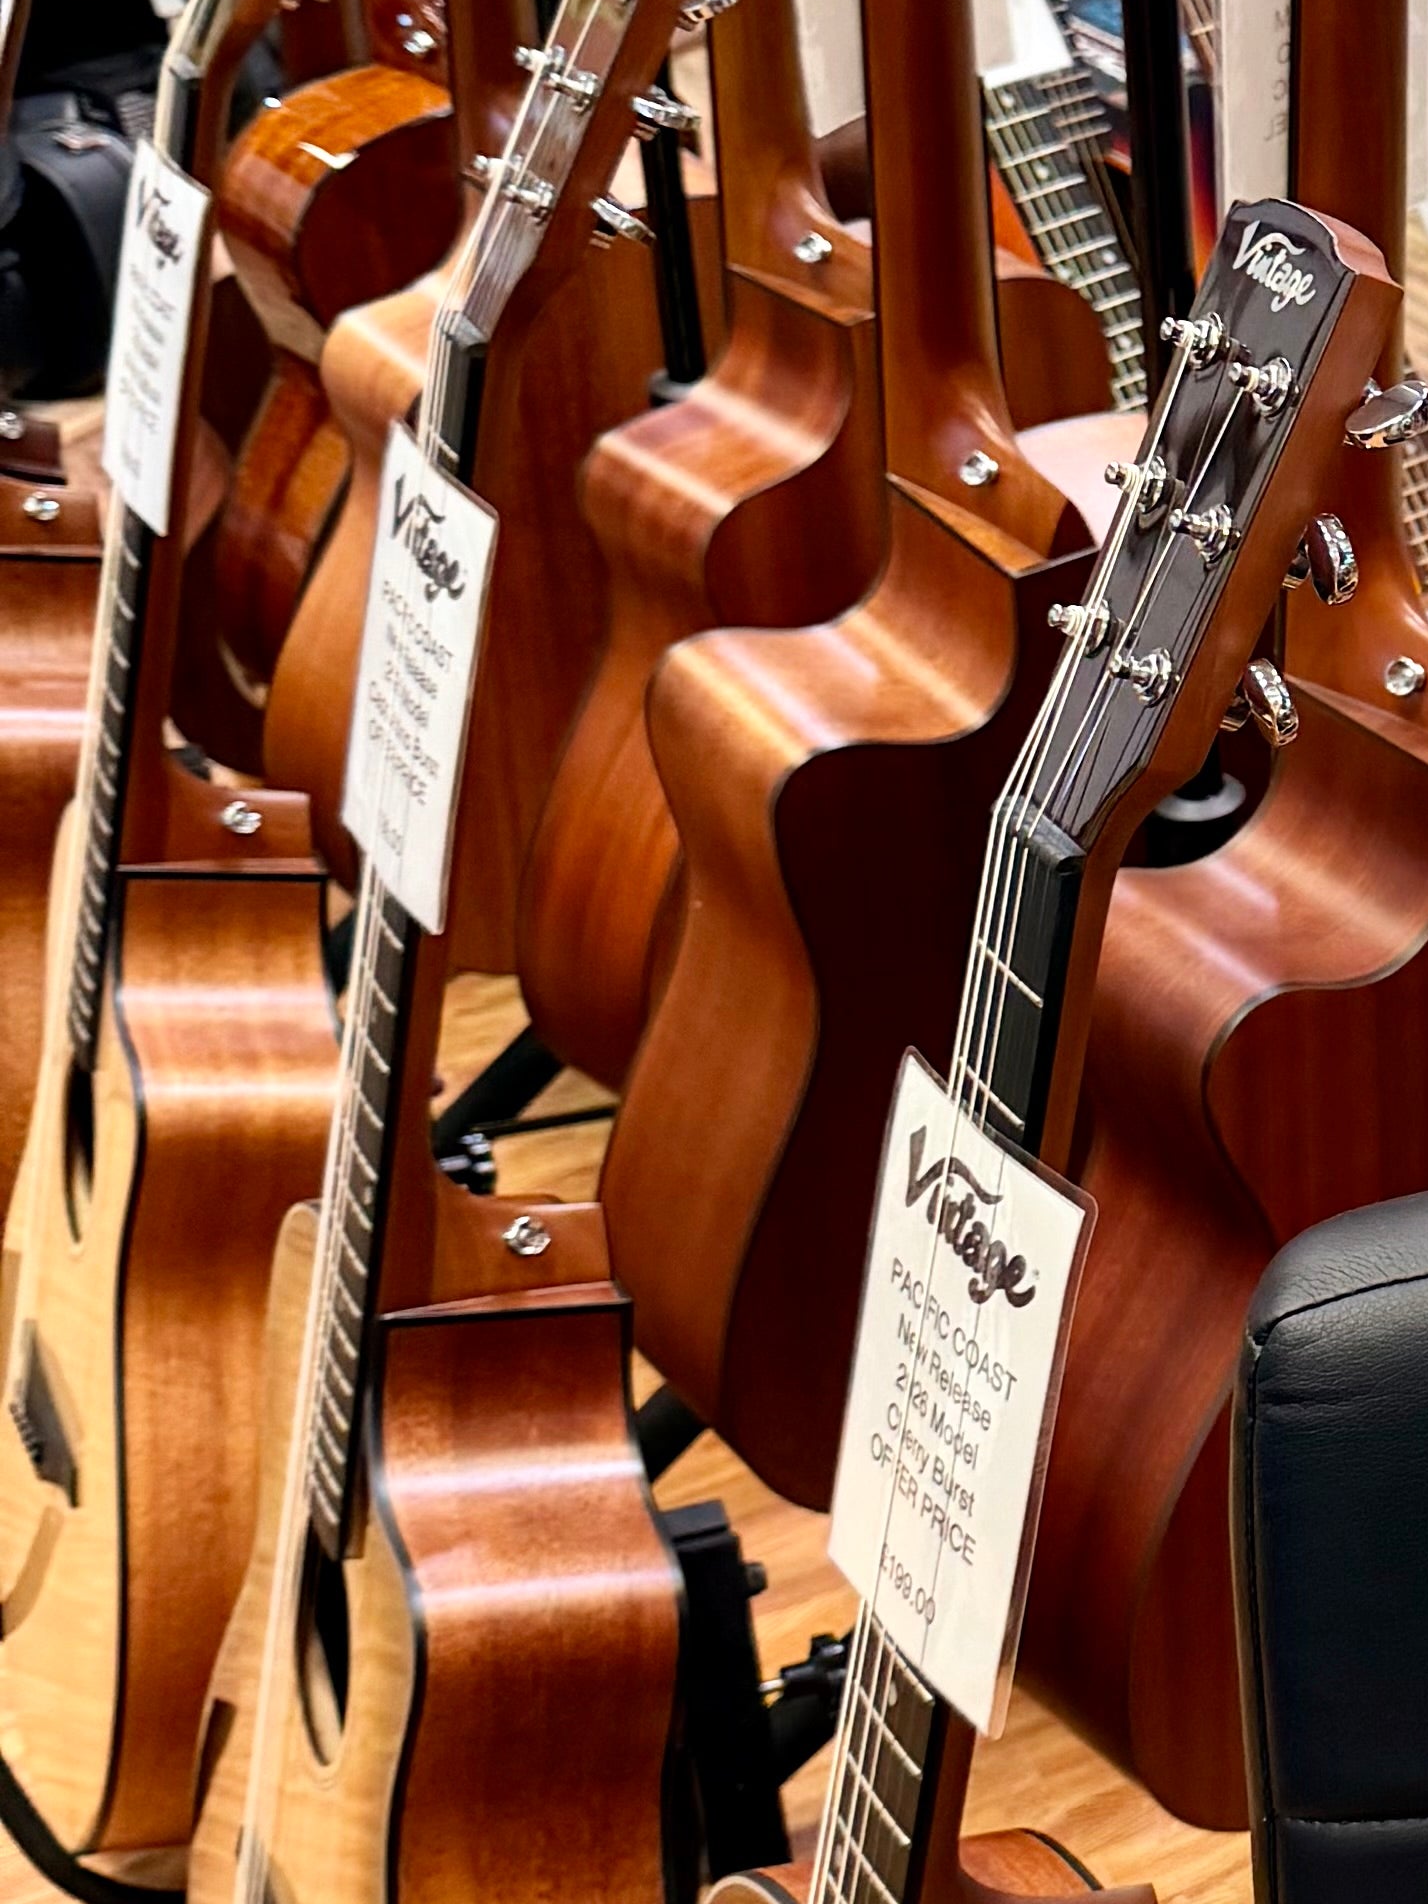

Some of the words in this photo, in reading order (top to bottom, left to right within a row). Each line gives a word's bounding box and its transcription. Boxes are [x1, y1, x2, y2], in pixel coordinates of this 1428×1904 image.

[1232, 220, 1317, 313] Vintage
[389, 473, 466, 603] Vintage
[904, 1125, 1036, 1308] Vintage
[890, 1257, 950, 1341] PACFIC
[952, 1326, 1018, 1402] COAST
[929, 1351, 992, 1432] Release
[929, 1402, 980, 1472] Model
[919, 1492, 976, 1566] PRICE
[932, 1456, 976, 1518] Burst
